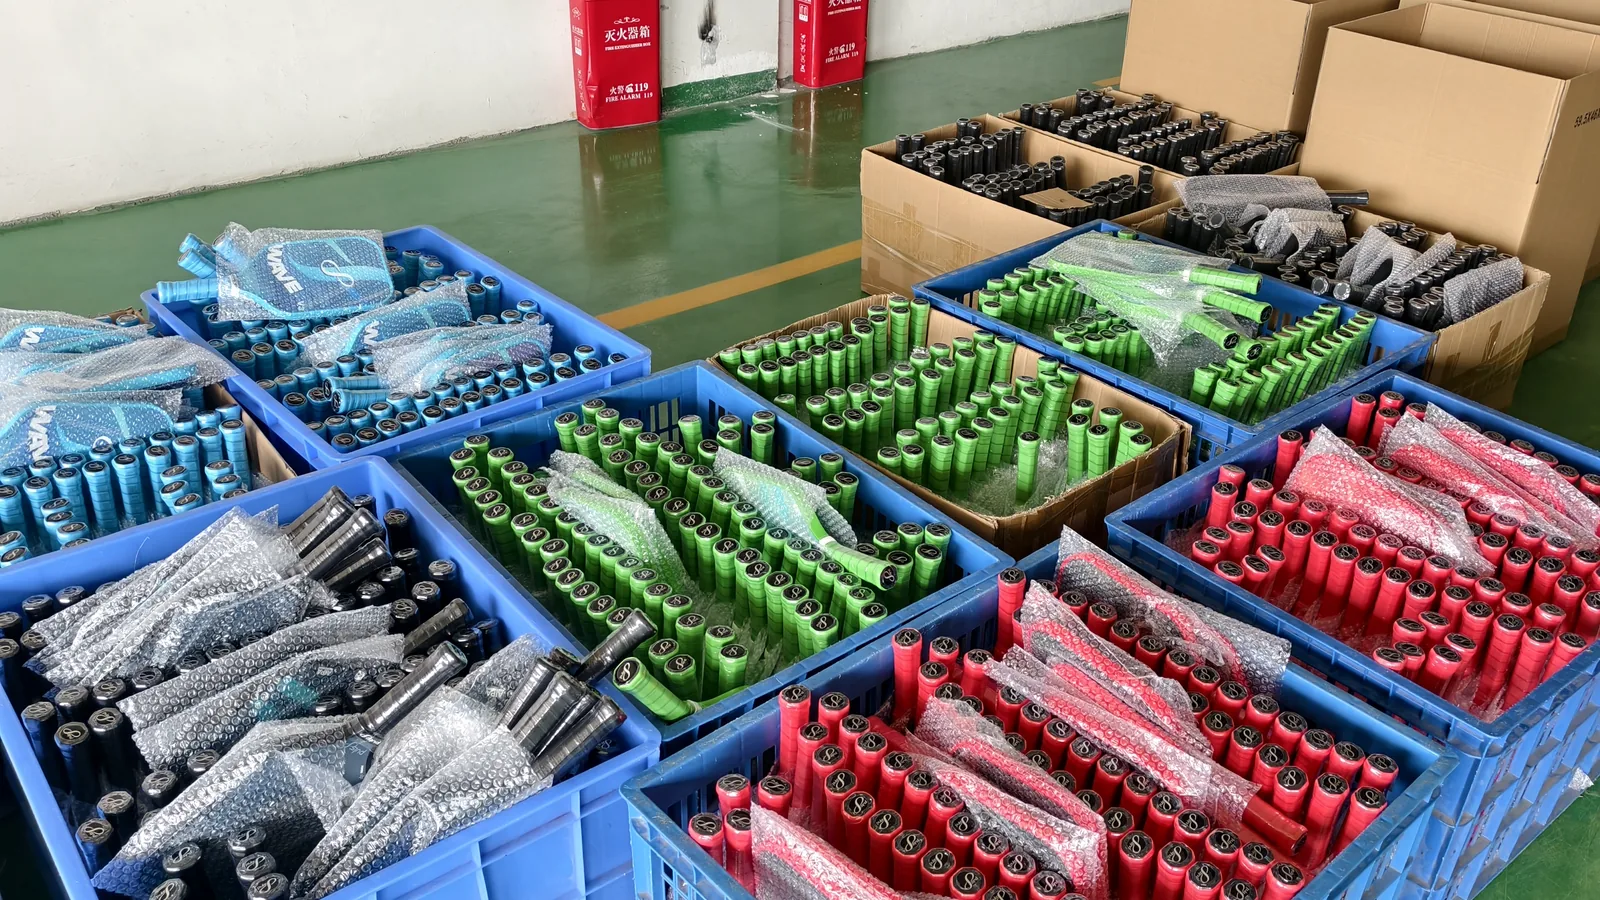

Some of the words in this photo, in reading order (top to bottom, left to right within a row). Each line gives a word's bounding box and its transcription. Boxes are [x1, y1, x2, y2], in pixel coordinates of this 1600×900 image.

[604, 25, 650, 43] 灭火器箱
[846, 42, 856, 52] 119
[835, 52, 850, 61] ALARM
[609, 85, 624, 95] 火警
[634, 82, 649, 92] 119
[605, 95, 619, 103] FIRE
[619, 93, 641, 101] ALARM
[267, 245, 304, 294] WAVE
[28, 405, 57, 463] WAV
